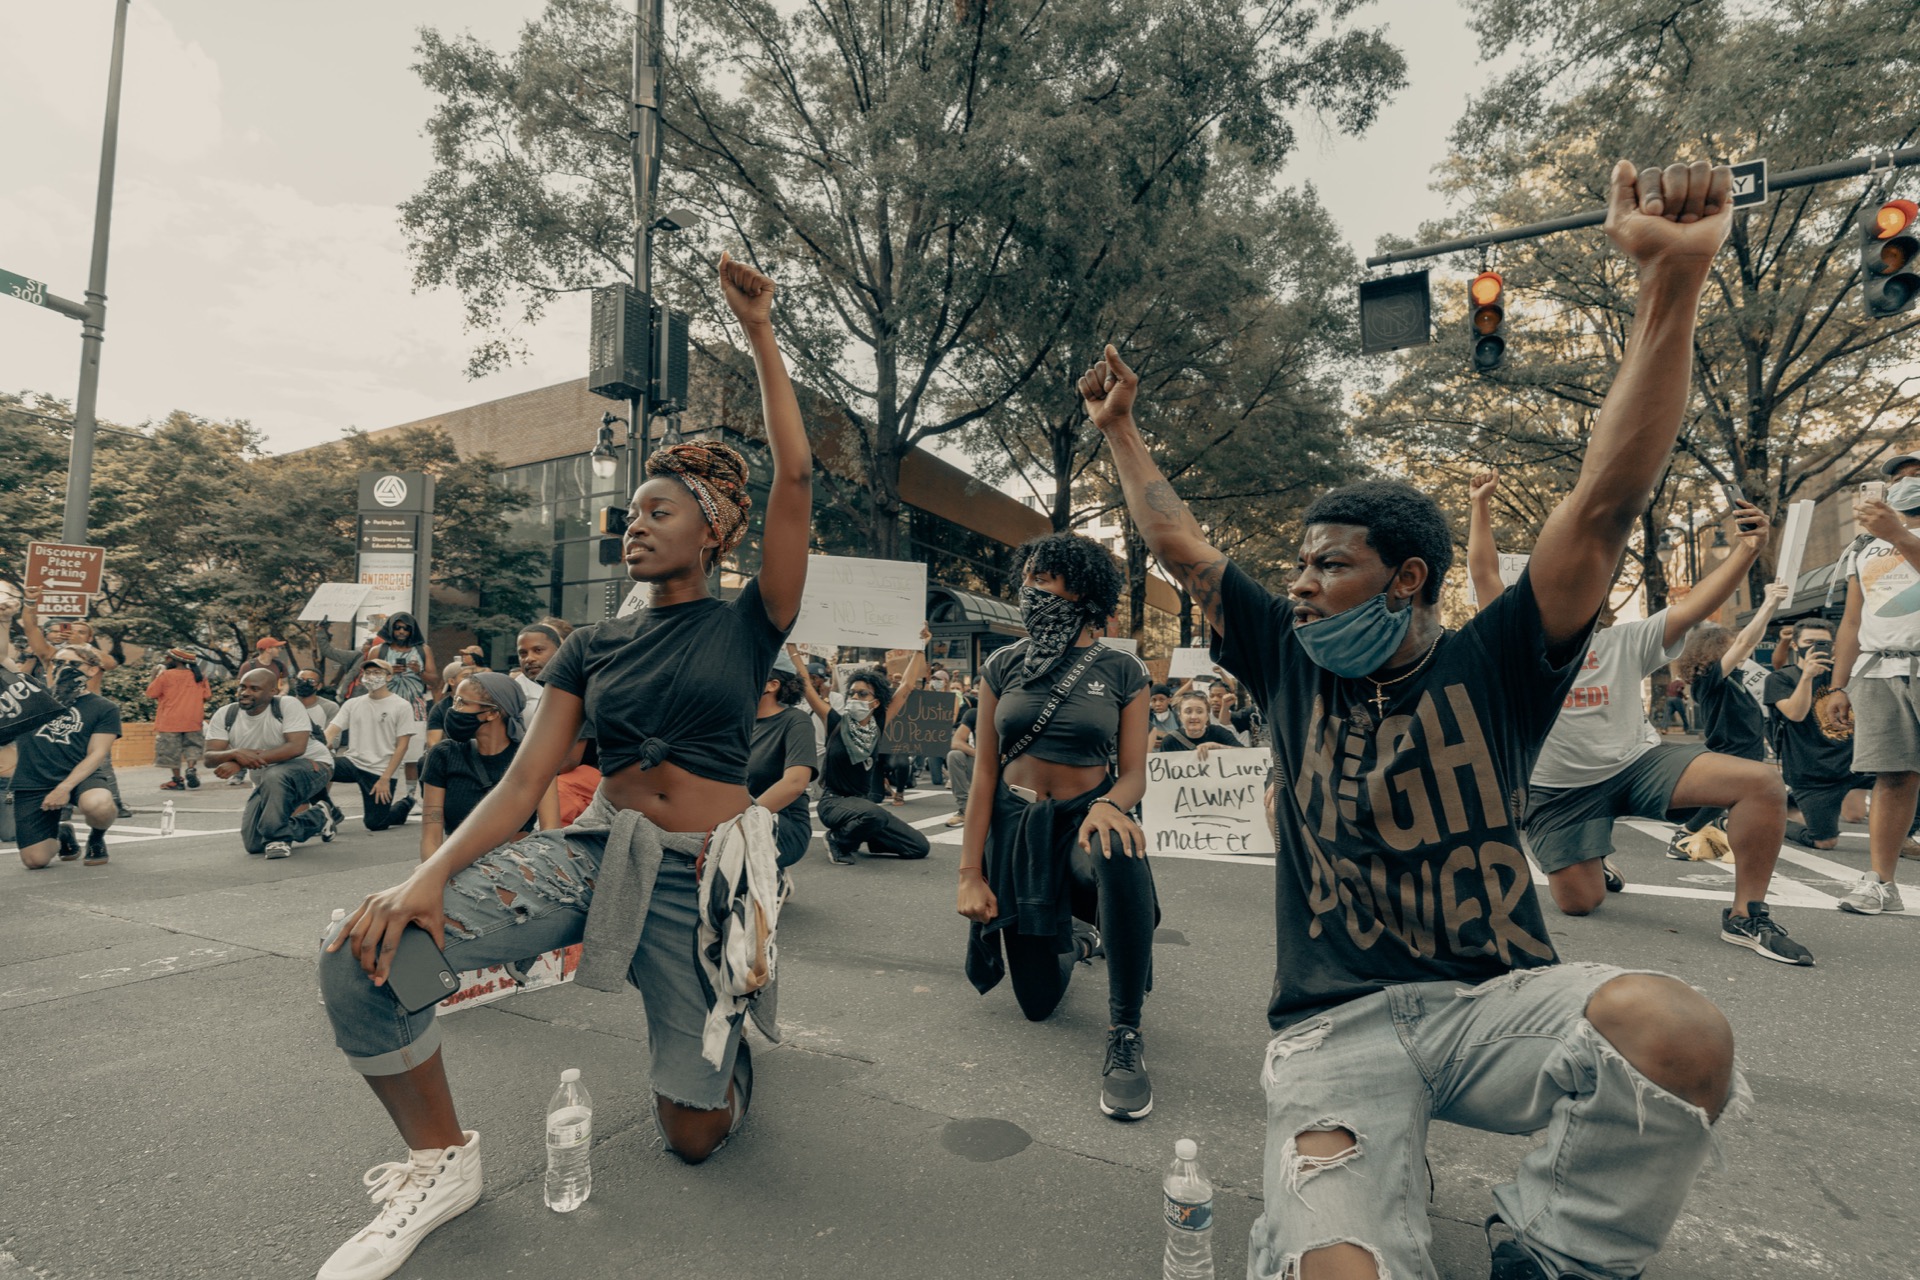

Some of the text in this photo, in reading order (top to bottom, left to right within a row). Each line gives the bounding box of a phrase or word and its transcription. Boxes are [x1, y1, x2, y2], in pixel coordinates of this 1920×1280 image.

[11, 285, 43, 305] 300
[26, 279, 44, 294] ST
[34, 545, 98, 562] Discovery
[48, 556, 82, 568] Place
[40, 566, 87, 580] Parking
[361, 572, 412, 588] ANTARCTIC
[833, 564, 854, 585] NO
[37, 604, 82, 613] BLOCK
[42, 595, 79, 604] NEXT
[833, 600, 856, 624] NO
[1745, 671, 1766, 687] TER
[1563, 685, 1609, 708] SED!
[907, 695, 955, 721] Justice
[907, 721, 950, 742] Peace
[1008, 734, 1033, 757] GUESS
[1031, 696, 1061, 733] GUESS
[1148, 756, 1211, 782] Black
[1295, 682, 1508, 852] HIGH
[1174, 784, 1256, 813] ALWAYS
[1301, 823, 1554, 966] POWER
